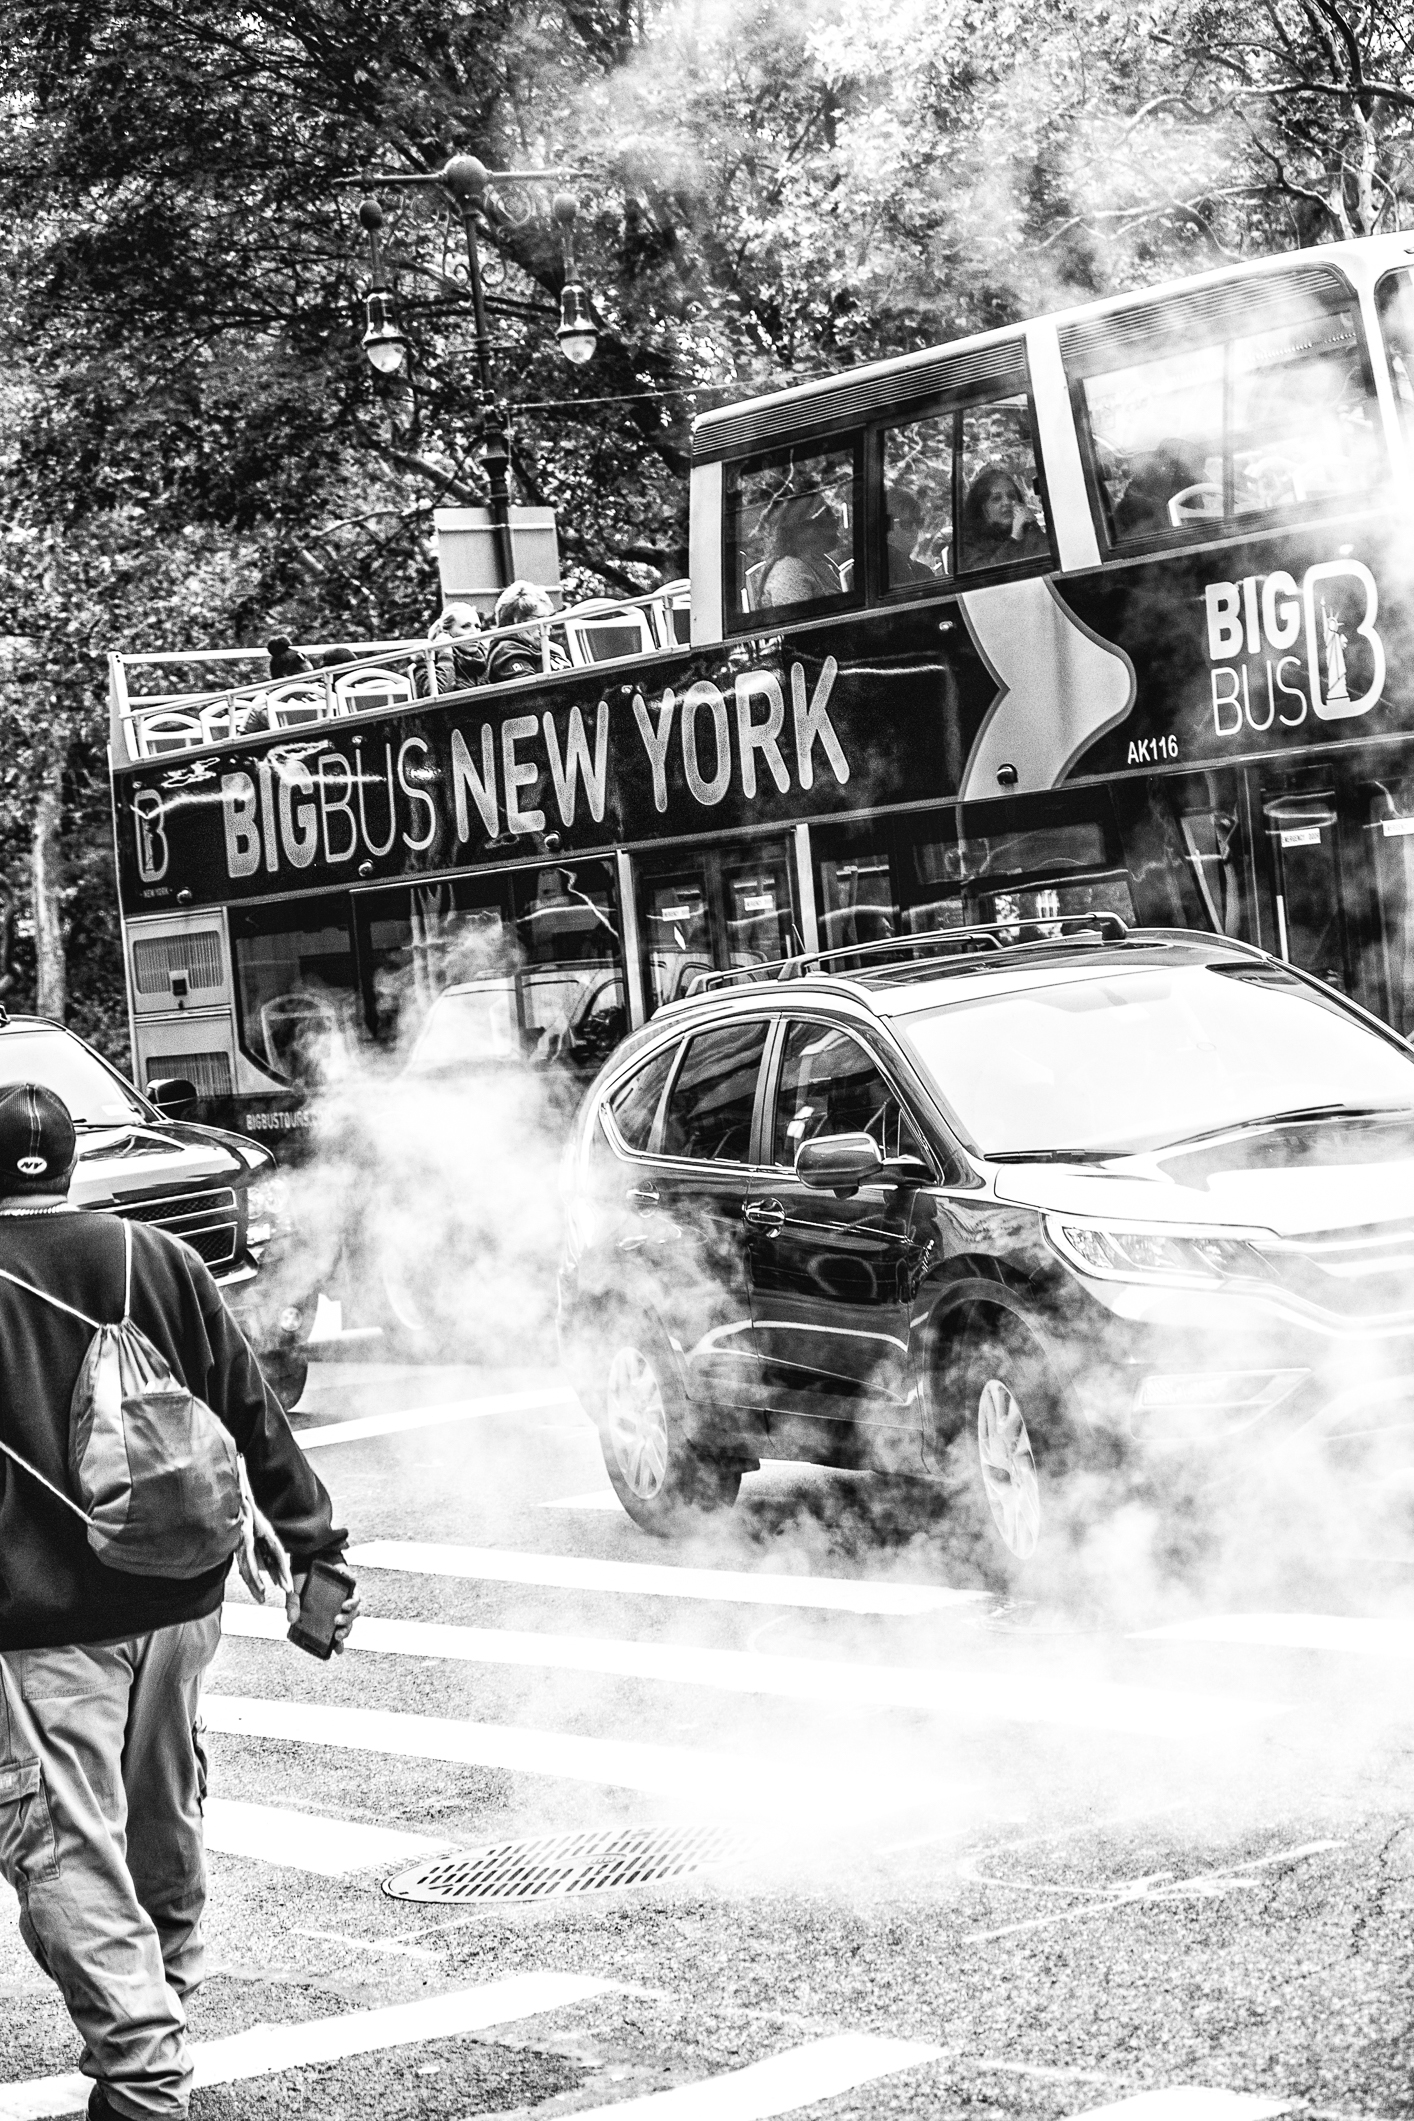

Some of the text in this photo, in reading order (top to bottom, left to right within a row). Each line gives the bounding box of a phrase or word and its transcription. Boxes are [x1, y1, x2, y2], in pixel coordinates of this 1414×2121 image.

[1205, 571, 1300, 660] BIG
[1211, 656, 1307, 736] BUS
[451, 701, 609, 843] NEW
[632, 655, 850, 813] YORK
[1127, 734, 1179, 765] AK116
[20, 1161, 43, 1170] NY
